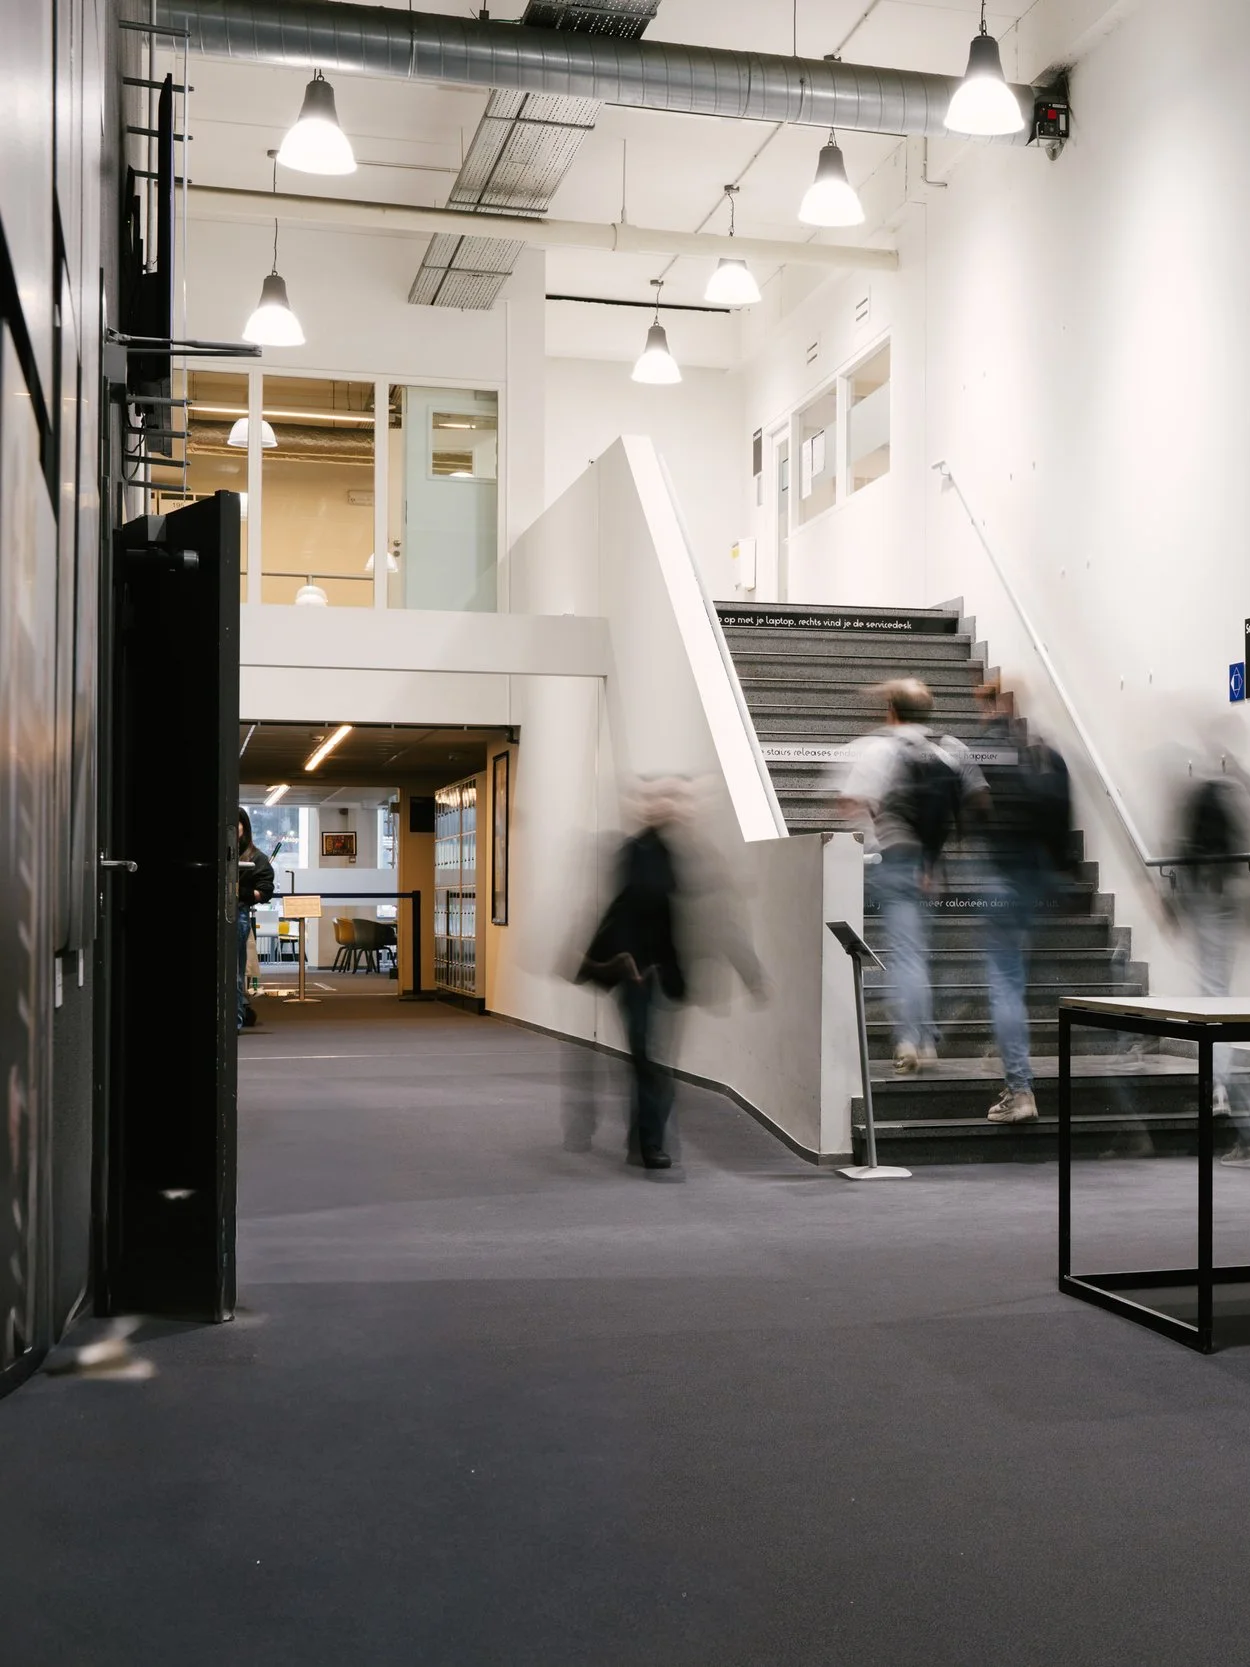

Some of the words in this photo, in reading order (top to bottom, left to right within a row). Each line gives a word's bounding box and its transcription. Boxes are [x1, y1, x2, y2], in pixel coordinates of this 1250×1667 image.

[724, 616, 736, 625] op
[737, 616, 754, 624] met
[756, 615, 765, 626] je
[798, 617, 822, 626] rechts
[823, 618, 842, 627] vind
[843, 619, 852, 629] je
[853, 618, 865, 628] de
[866, 620, 912, 629] servicedesk
[767, 748, 791, 756] stairs
[793, 747, 832, 757] releases
[945, 897, 988, 908] calorieën
